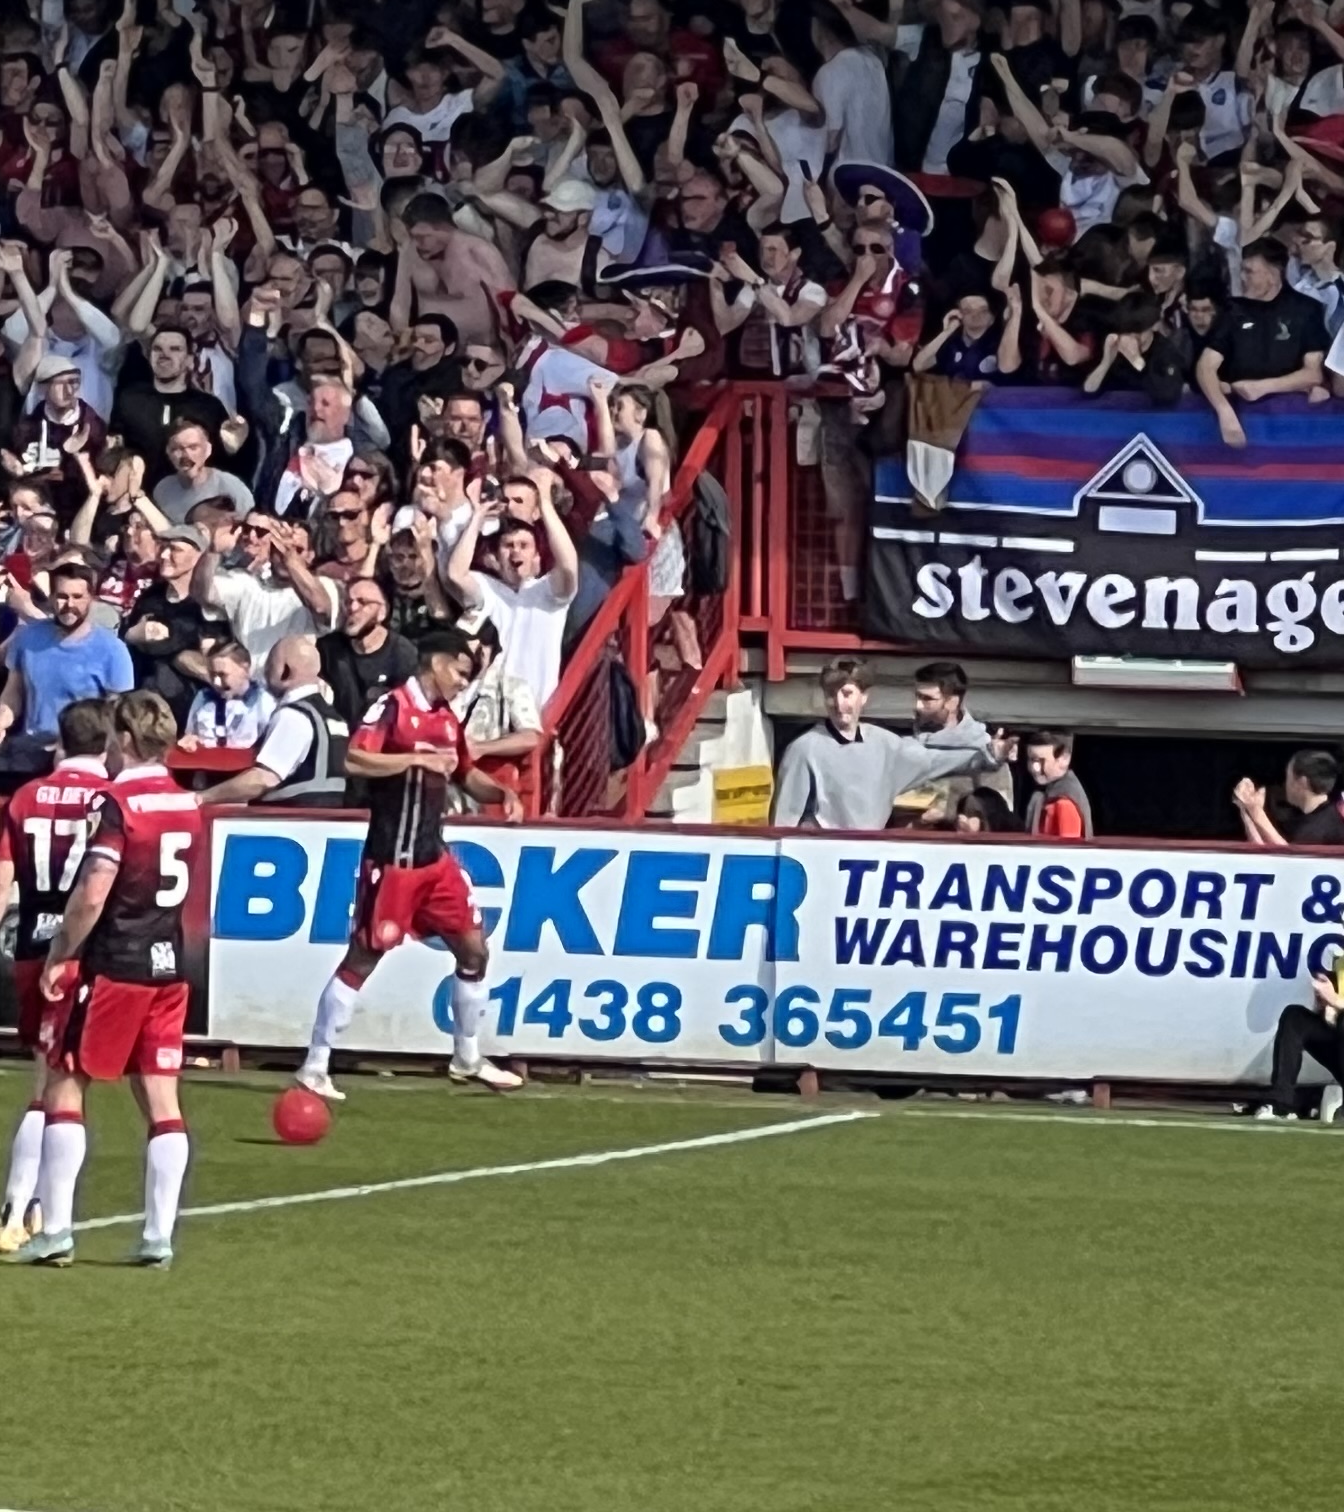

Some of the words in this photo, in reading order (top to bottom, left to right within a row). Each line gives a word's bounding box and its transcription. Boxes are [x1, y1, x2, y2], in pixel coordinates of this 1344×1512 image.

[23, 817, 88, 892] 17
[155, 832, 192, 907] 5
[837, 859, 1275, 920] TRANSPORT
[1302, 874, 1344, 923] &
[432, 976, 682, 1044] 01438
[718, 984, 1023, 1055] 365451
